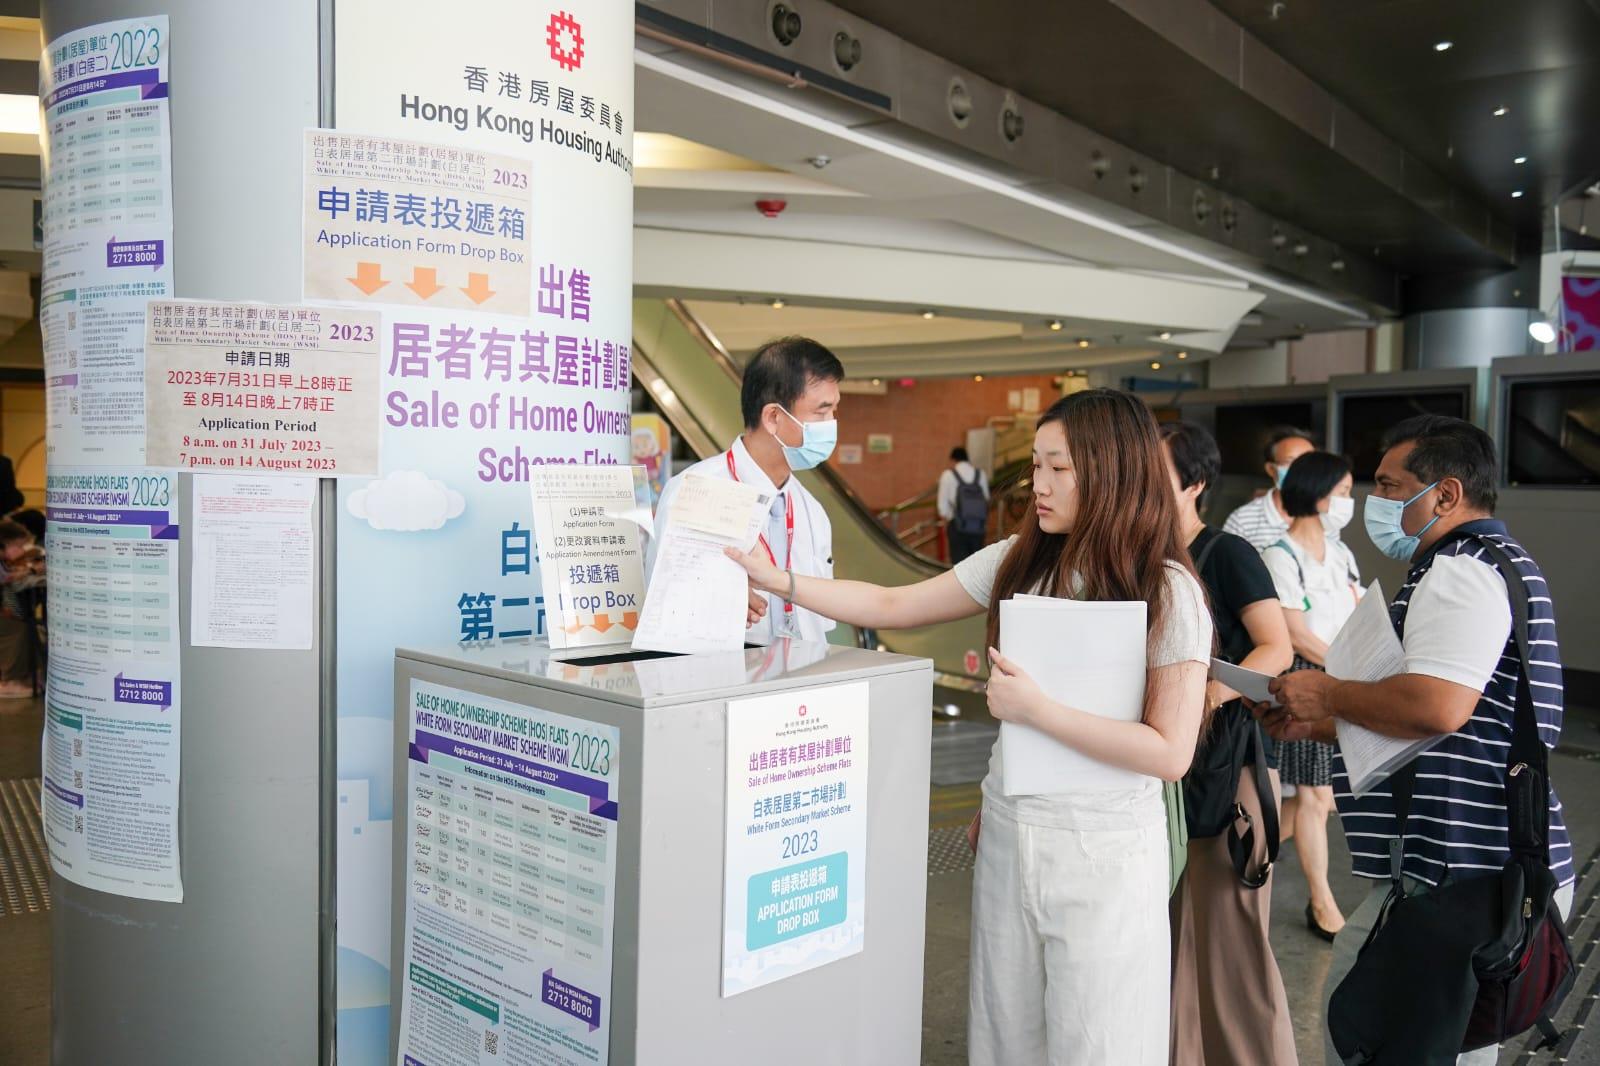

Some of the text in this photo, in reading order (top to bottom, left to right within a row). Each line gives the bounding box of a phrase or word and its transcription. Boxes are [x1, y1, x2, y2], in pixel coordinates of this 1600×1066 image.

[111, 28, 160, 70] 2023
[464, 66, 623, 135] 香港房屋委員會
[400, 94, 468, 131] Hong
[477, 105, 534, 142] Kong
[540, 118, 602, 163] Housing
[493, 169, 527, 189] 2023
[318, 186, 525, 241] 申請表投遞箱
[113, 252, 156, 264] 2712 8000
[317, 229, 523, 263] Application Form Drop Box
[538, 264, 591, 322] 出售
[152, 305, 320, 322] 出售居者有其屋計劃(居屋)單位
[152, 317, 374, 341] 白表居屋第二市場計劃(白居二) 2023
[225, 350, 290, 368] 申請日期
[388, 322, 632, 392] 居者有其屋計劃單
[167, 370, 353, 392] 2023年7月31日早上8時正
[198, 417, 317, 432] Application Period
[386, 390, 459, 428] Sale
[469, 392, 500, 429] of
[509, 396, 577, 433] Home
[183, 436, 321, 453] 8 a.m. on 31 July 2023
[179, 454, 336, 471] 7 p.m. on 14 August 2023
[88, 492, 109, 506] SCHEME
[110, 491, 129, 507] (WSM)
[111, 476, 129, 490] FLATS
[132, 477, 169, 507] 2023
[563, 520, 615, 529] Application Form
[569, 506, 605, 517] (1)申請表
[546, 550, 581, 561] Application
[583, 550, 620, 558] Amendment
[554, 535, 626, 547] (2)更改資料申請表
[569, 564, 620, 585] 投遞箱
[605, 590, 636, 608] Box
[120, 690, 163, 702] 2712 8000
[416, 692, 610, 776] SALE OF HOME OWNERSHIP SCHEME (HOS) FLATS 2023
[416, 710, 569, 768] WHITE FORM SECONDARY MARKET SCHEME (WSM)
[454, 746, 479, 760] Application
[480, 752, 497, 764] Period:
[497, 758, 503, 766] 31
[504, 760, 513, 771] July
[519, 764, 524, 772] 14
[526, 766, 542, 778] August
[749, 734, 851, 772] 出售居者有其屋計劃單位
[464, 766, 488, 778] Information
[504, 777, 514, 787] HOS
[514, 780, 546, 796] Developments
[748, 758, 852, 788] Sale of Home Ownership Scheme Flats
[753, 780, 846, 820] 白表居屋第二市場計劃
[747, 804, 851, 836] White Form Secondary Market Scheme
[782, 830, 818, 859] 2023
[771, 865, 828, 897] 申請表投遞箱
[757, 886, 839, 922] APPLICATION FORM
[777, 909, 820, 935] DROP BOX
[548, 989, 592, 1019] 2712 8000
